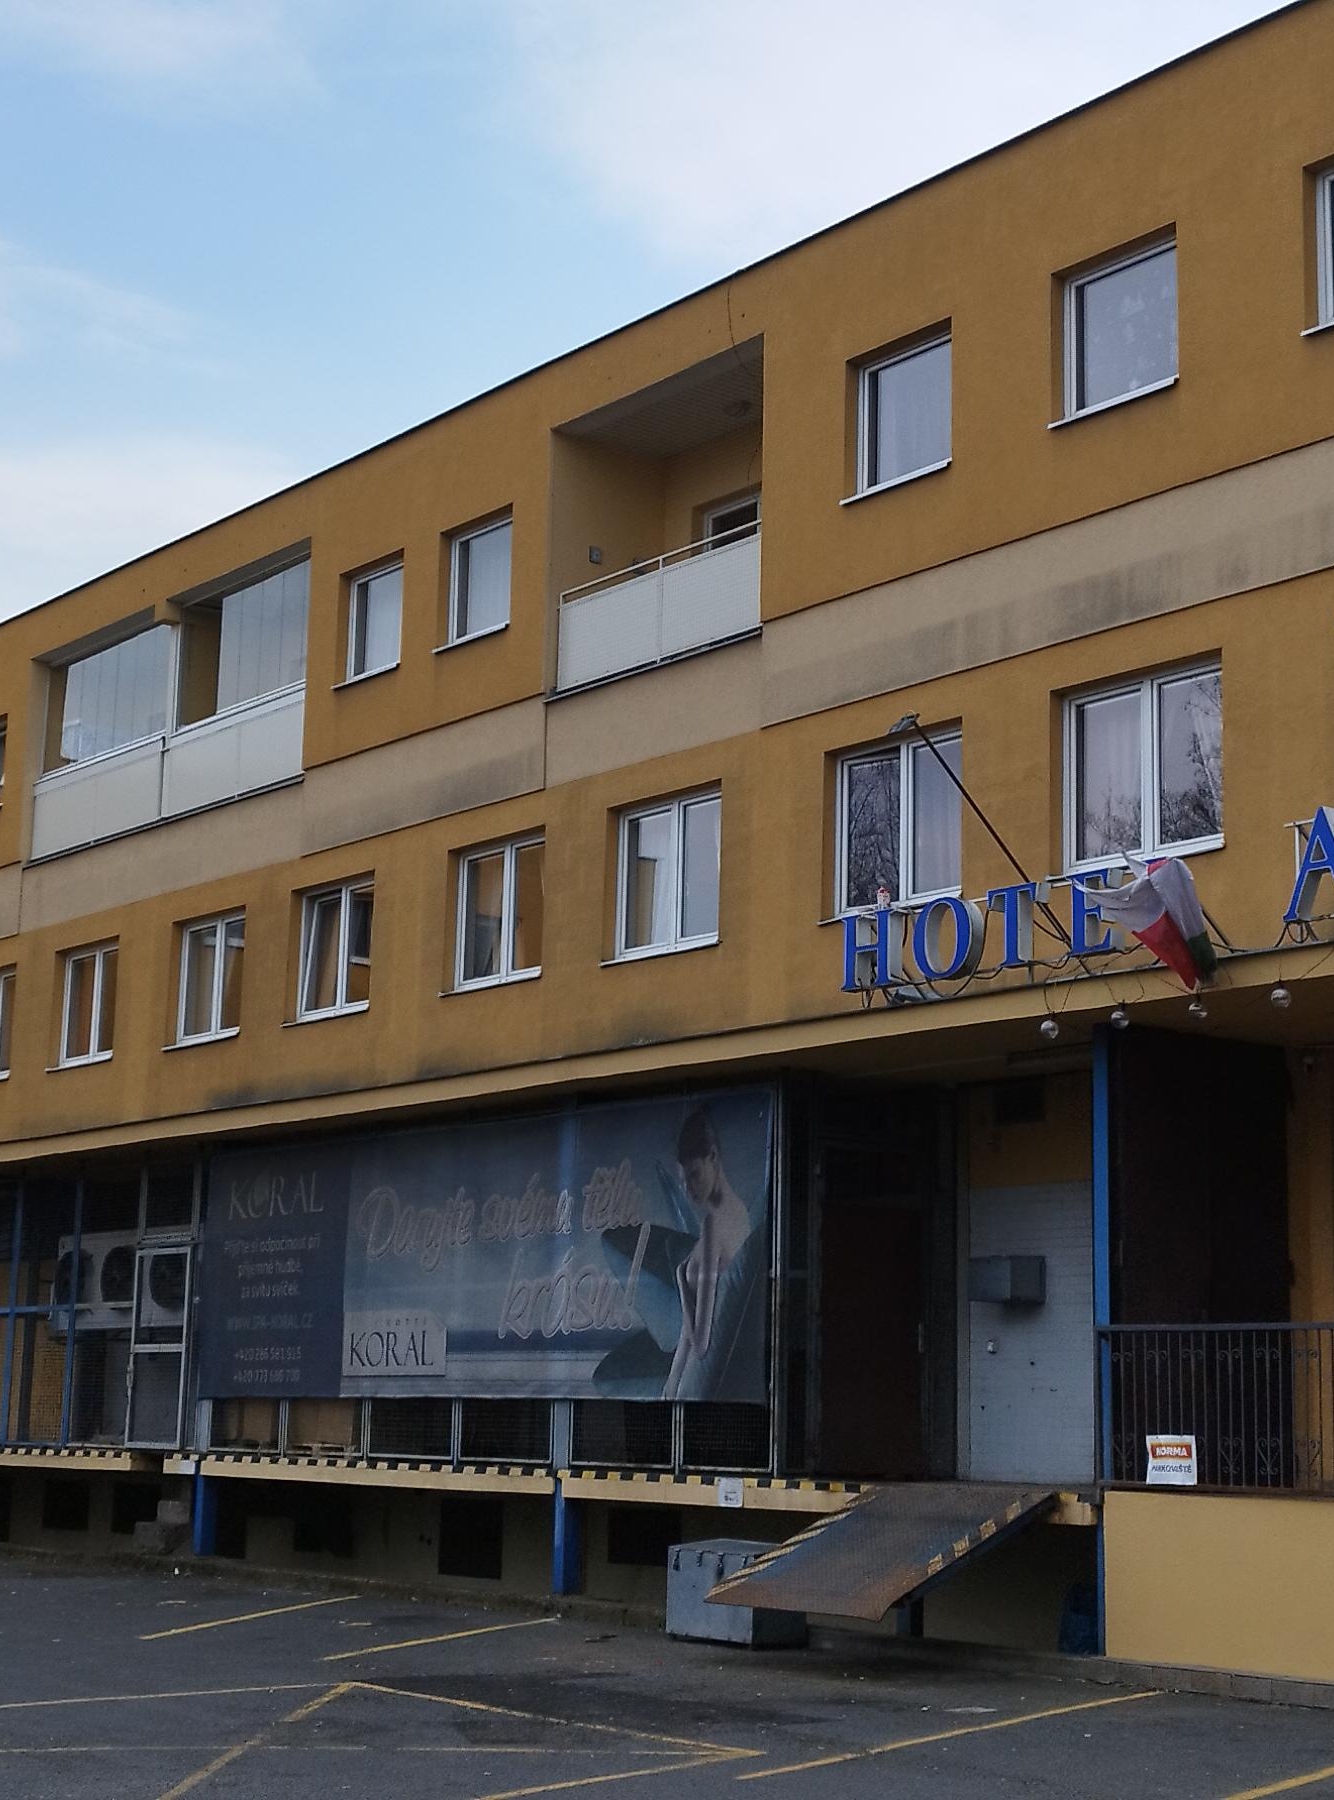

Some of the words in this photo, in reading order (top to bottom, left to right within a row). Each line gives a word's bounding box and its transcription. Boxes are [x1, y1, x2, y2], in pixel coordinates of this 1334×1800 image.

[840, 857, 1171, 992] HOTE
[227, 1170, 324, 1220] KORAL
[358, 1185, 475, 1272] Darujte
[478, 1172, 574, 1242] svému
[498, 1222, 651, 1340] krásu!
[349, 1330, 434, 1367] KORAL
[1155, 1446, 1189, 1457] NORMA
